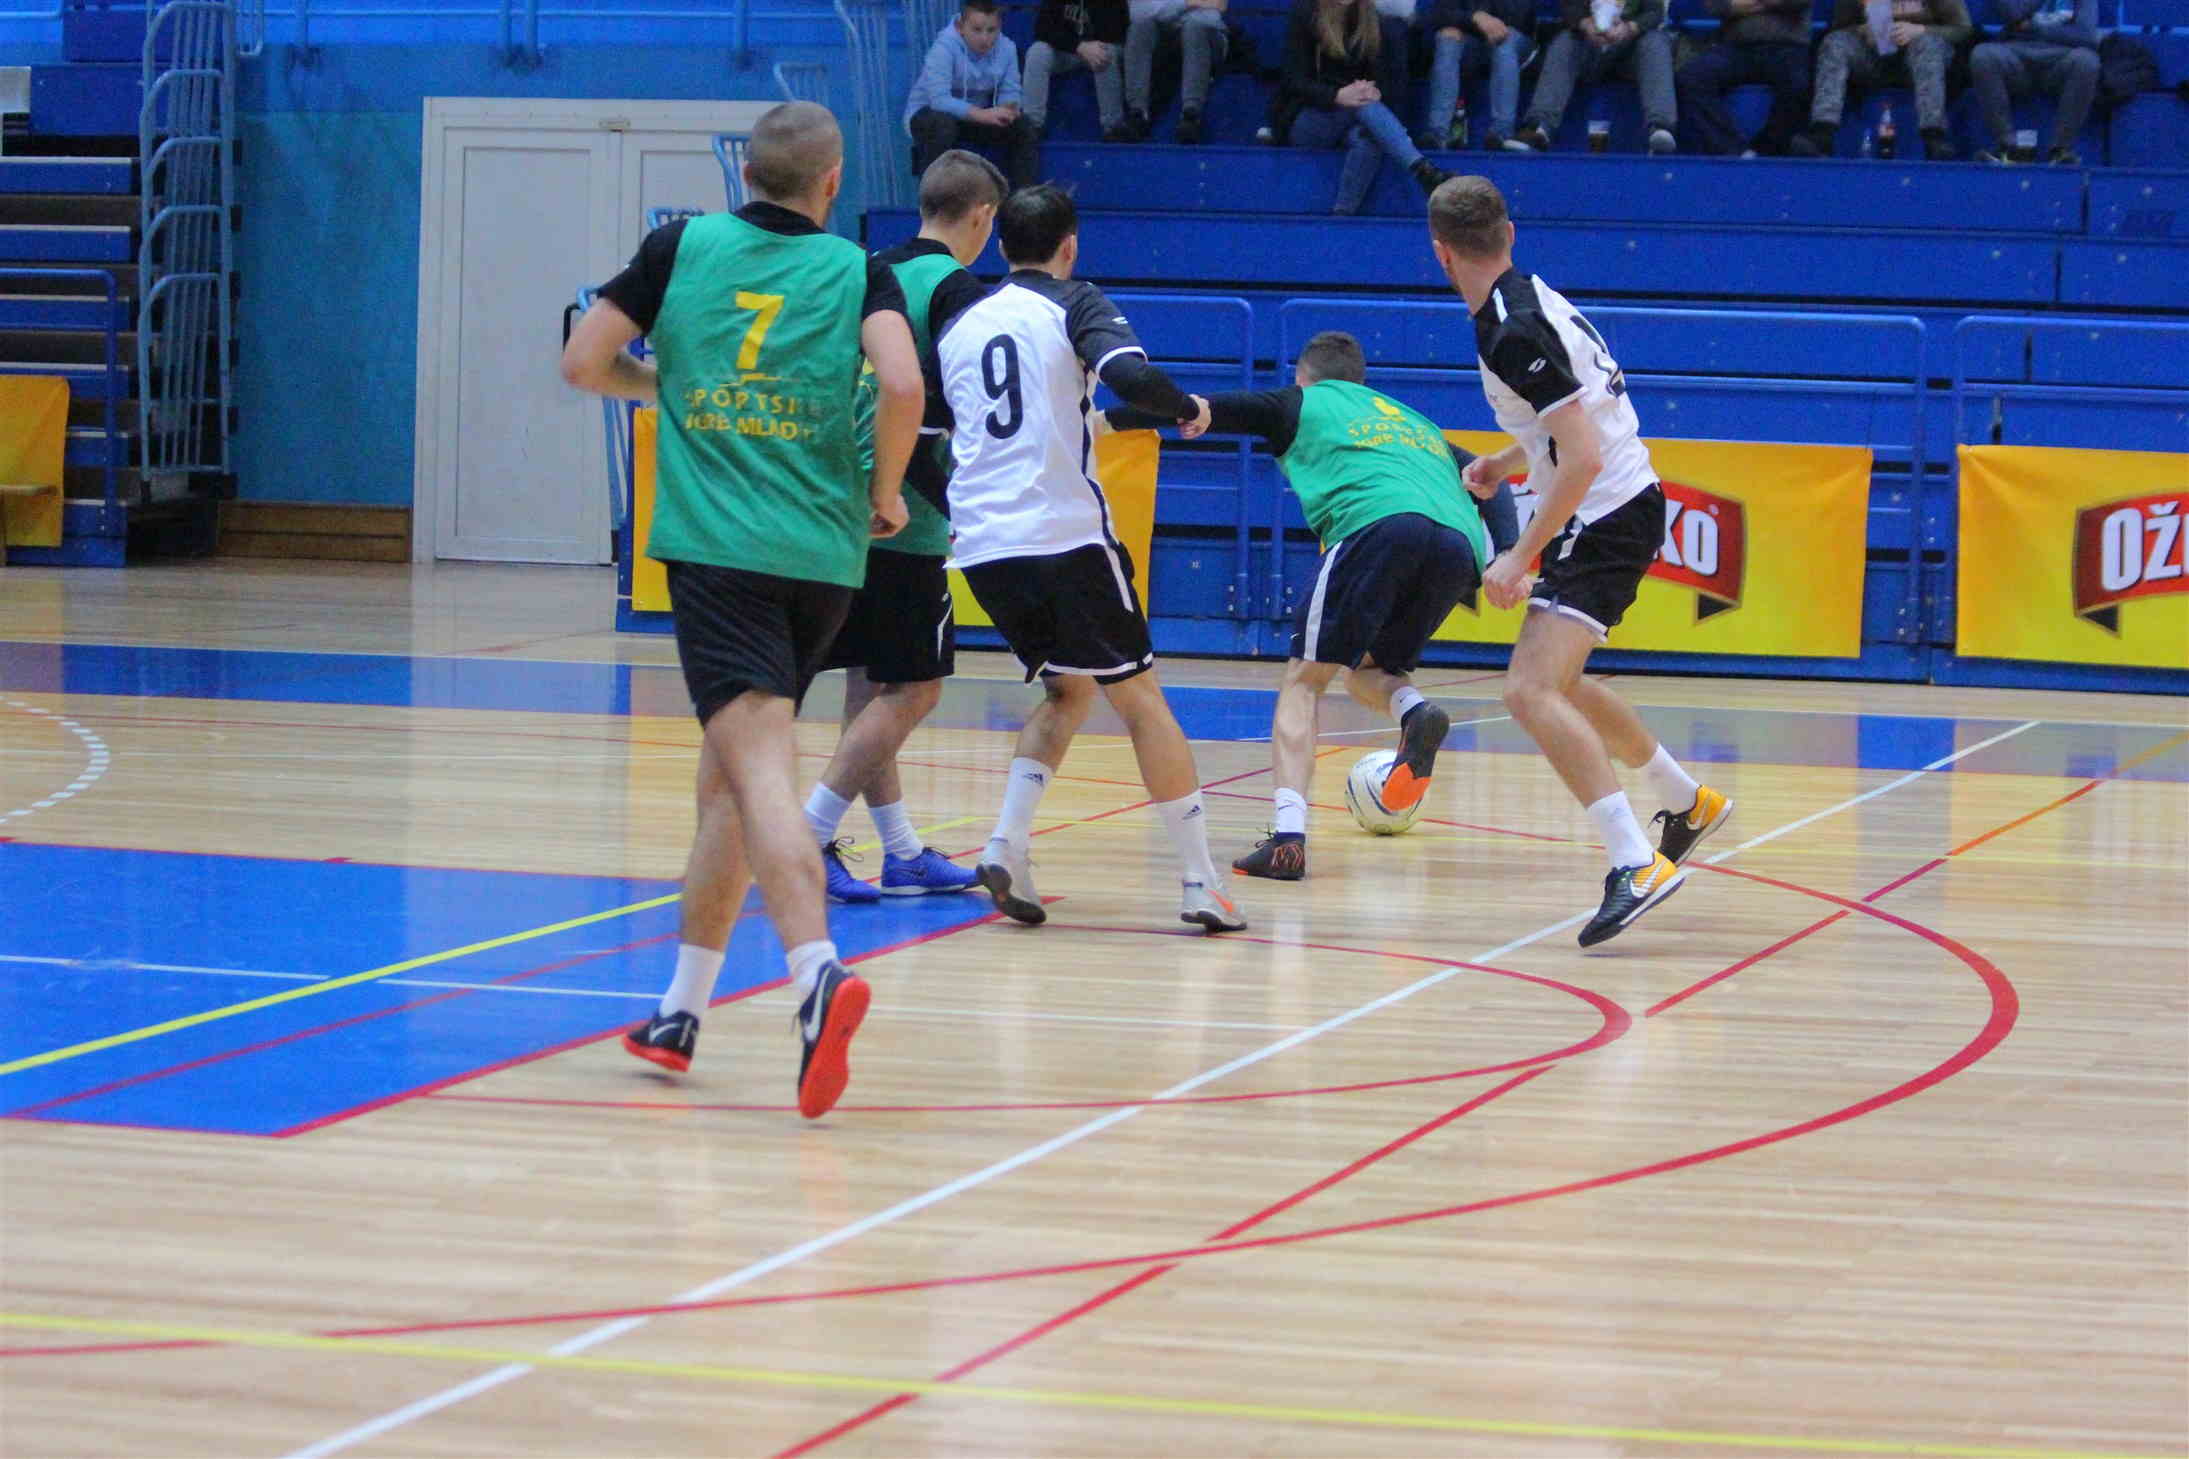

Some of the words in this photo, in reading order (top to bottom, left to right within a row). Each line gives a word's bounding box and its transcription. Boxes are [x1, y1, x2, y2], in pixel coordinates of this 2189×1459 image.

[735, 291, 784, 369] 7
[981, 334, 1023, 439] 9
[2102, 500, 2189, 592] OŽ
